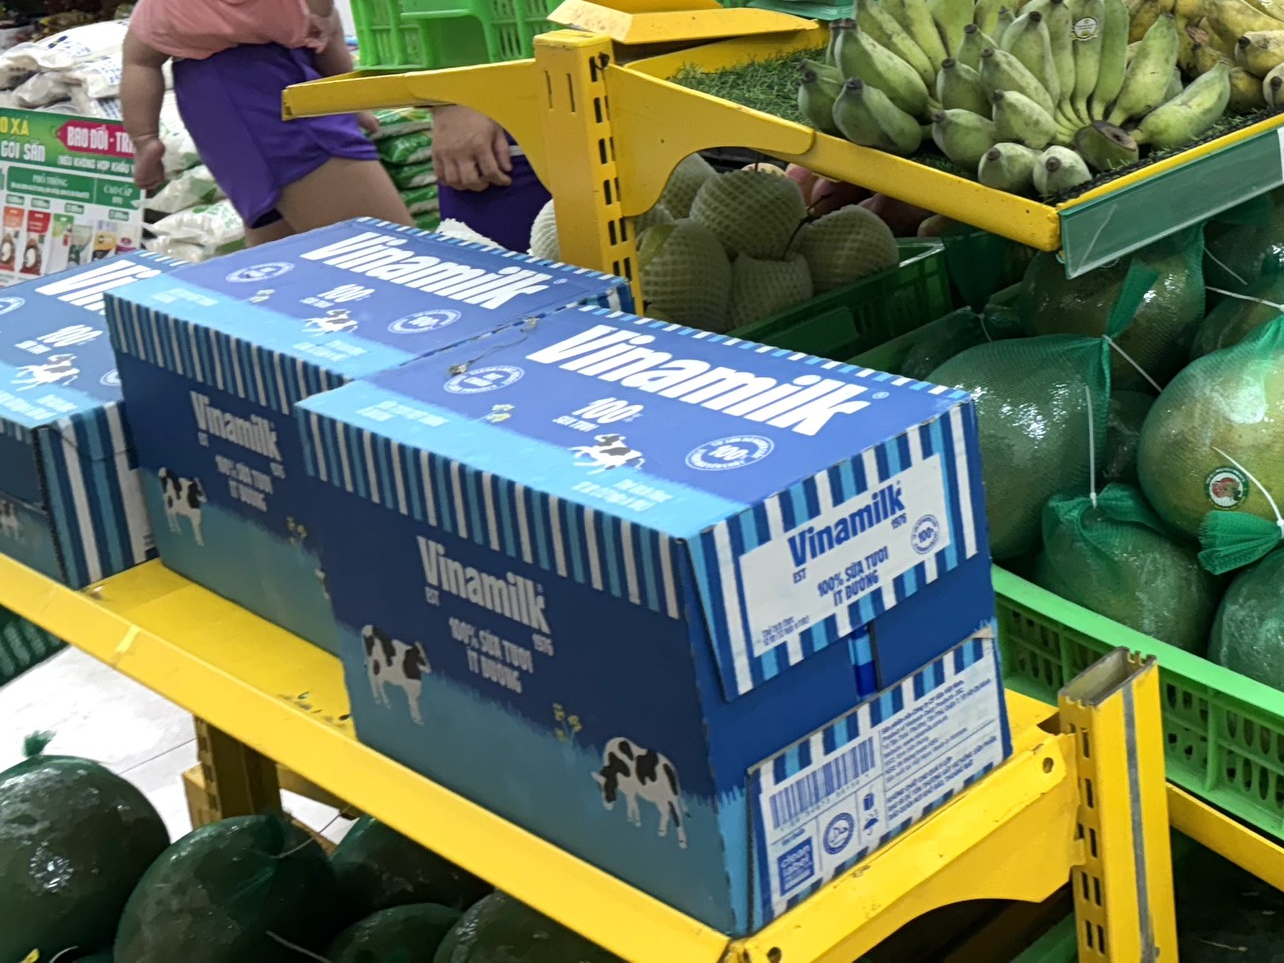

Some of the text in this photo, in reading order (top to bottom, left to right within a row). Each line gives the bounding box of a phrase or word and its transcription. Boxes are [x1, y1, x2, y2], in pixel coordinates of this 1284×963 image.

[67, 126, 89, 149] BAO
[300, 232, 553, 309] Vinamilk
[525, 324, 871, 436] Vinamilk
[190, 390, 282, 462] Vinamilk
[788, 482, 905, 567] Vinamilk
[416, 535, 551, 634] Vinamilk
[792, 568, 806, 584] EST
[817, 572, 844, 597] 100%
